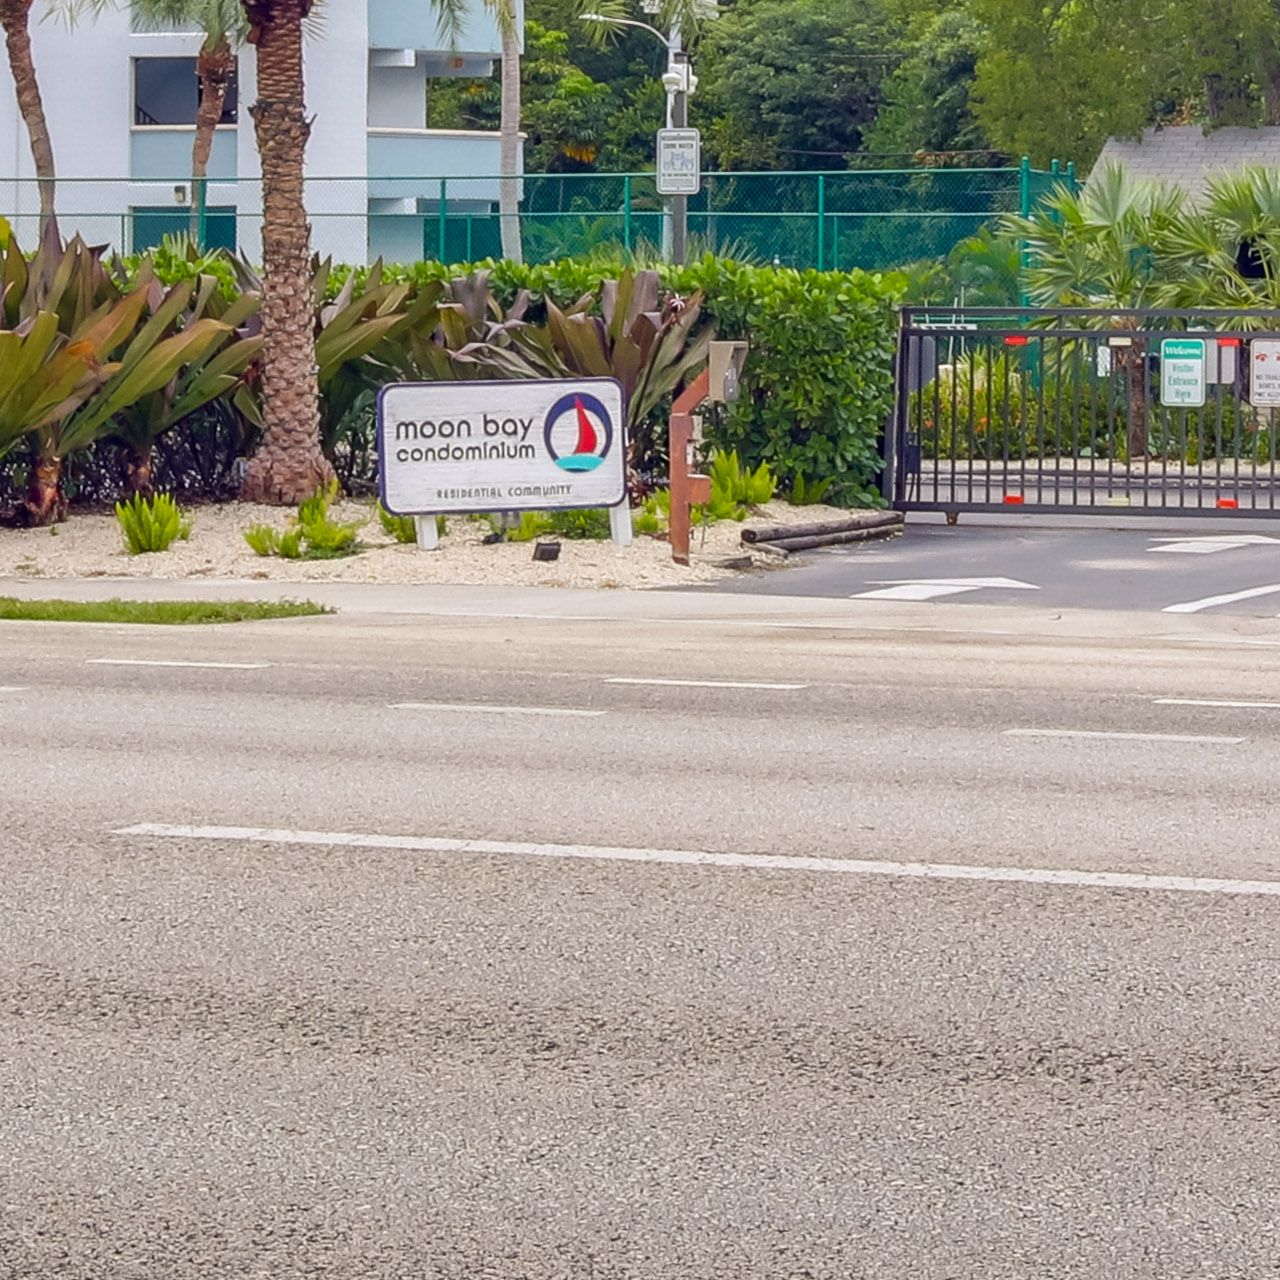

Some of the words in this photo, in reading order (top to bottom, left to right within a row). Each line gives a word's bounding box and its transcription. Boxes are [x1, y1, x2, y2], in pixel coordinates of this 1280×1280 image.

[1165, 345, 1202, 355] Welcome
[1168, 376, 1199, 386] Entrance
[396, 419, 471, 439] moon
[483, 413, 534, 442] bay
[396, 441, 535, 462] condominium
[436, 487, 503, 499] RESIDENTIAL
[507, 484, 573, 497] COMMUNITY
